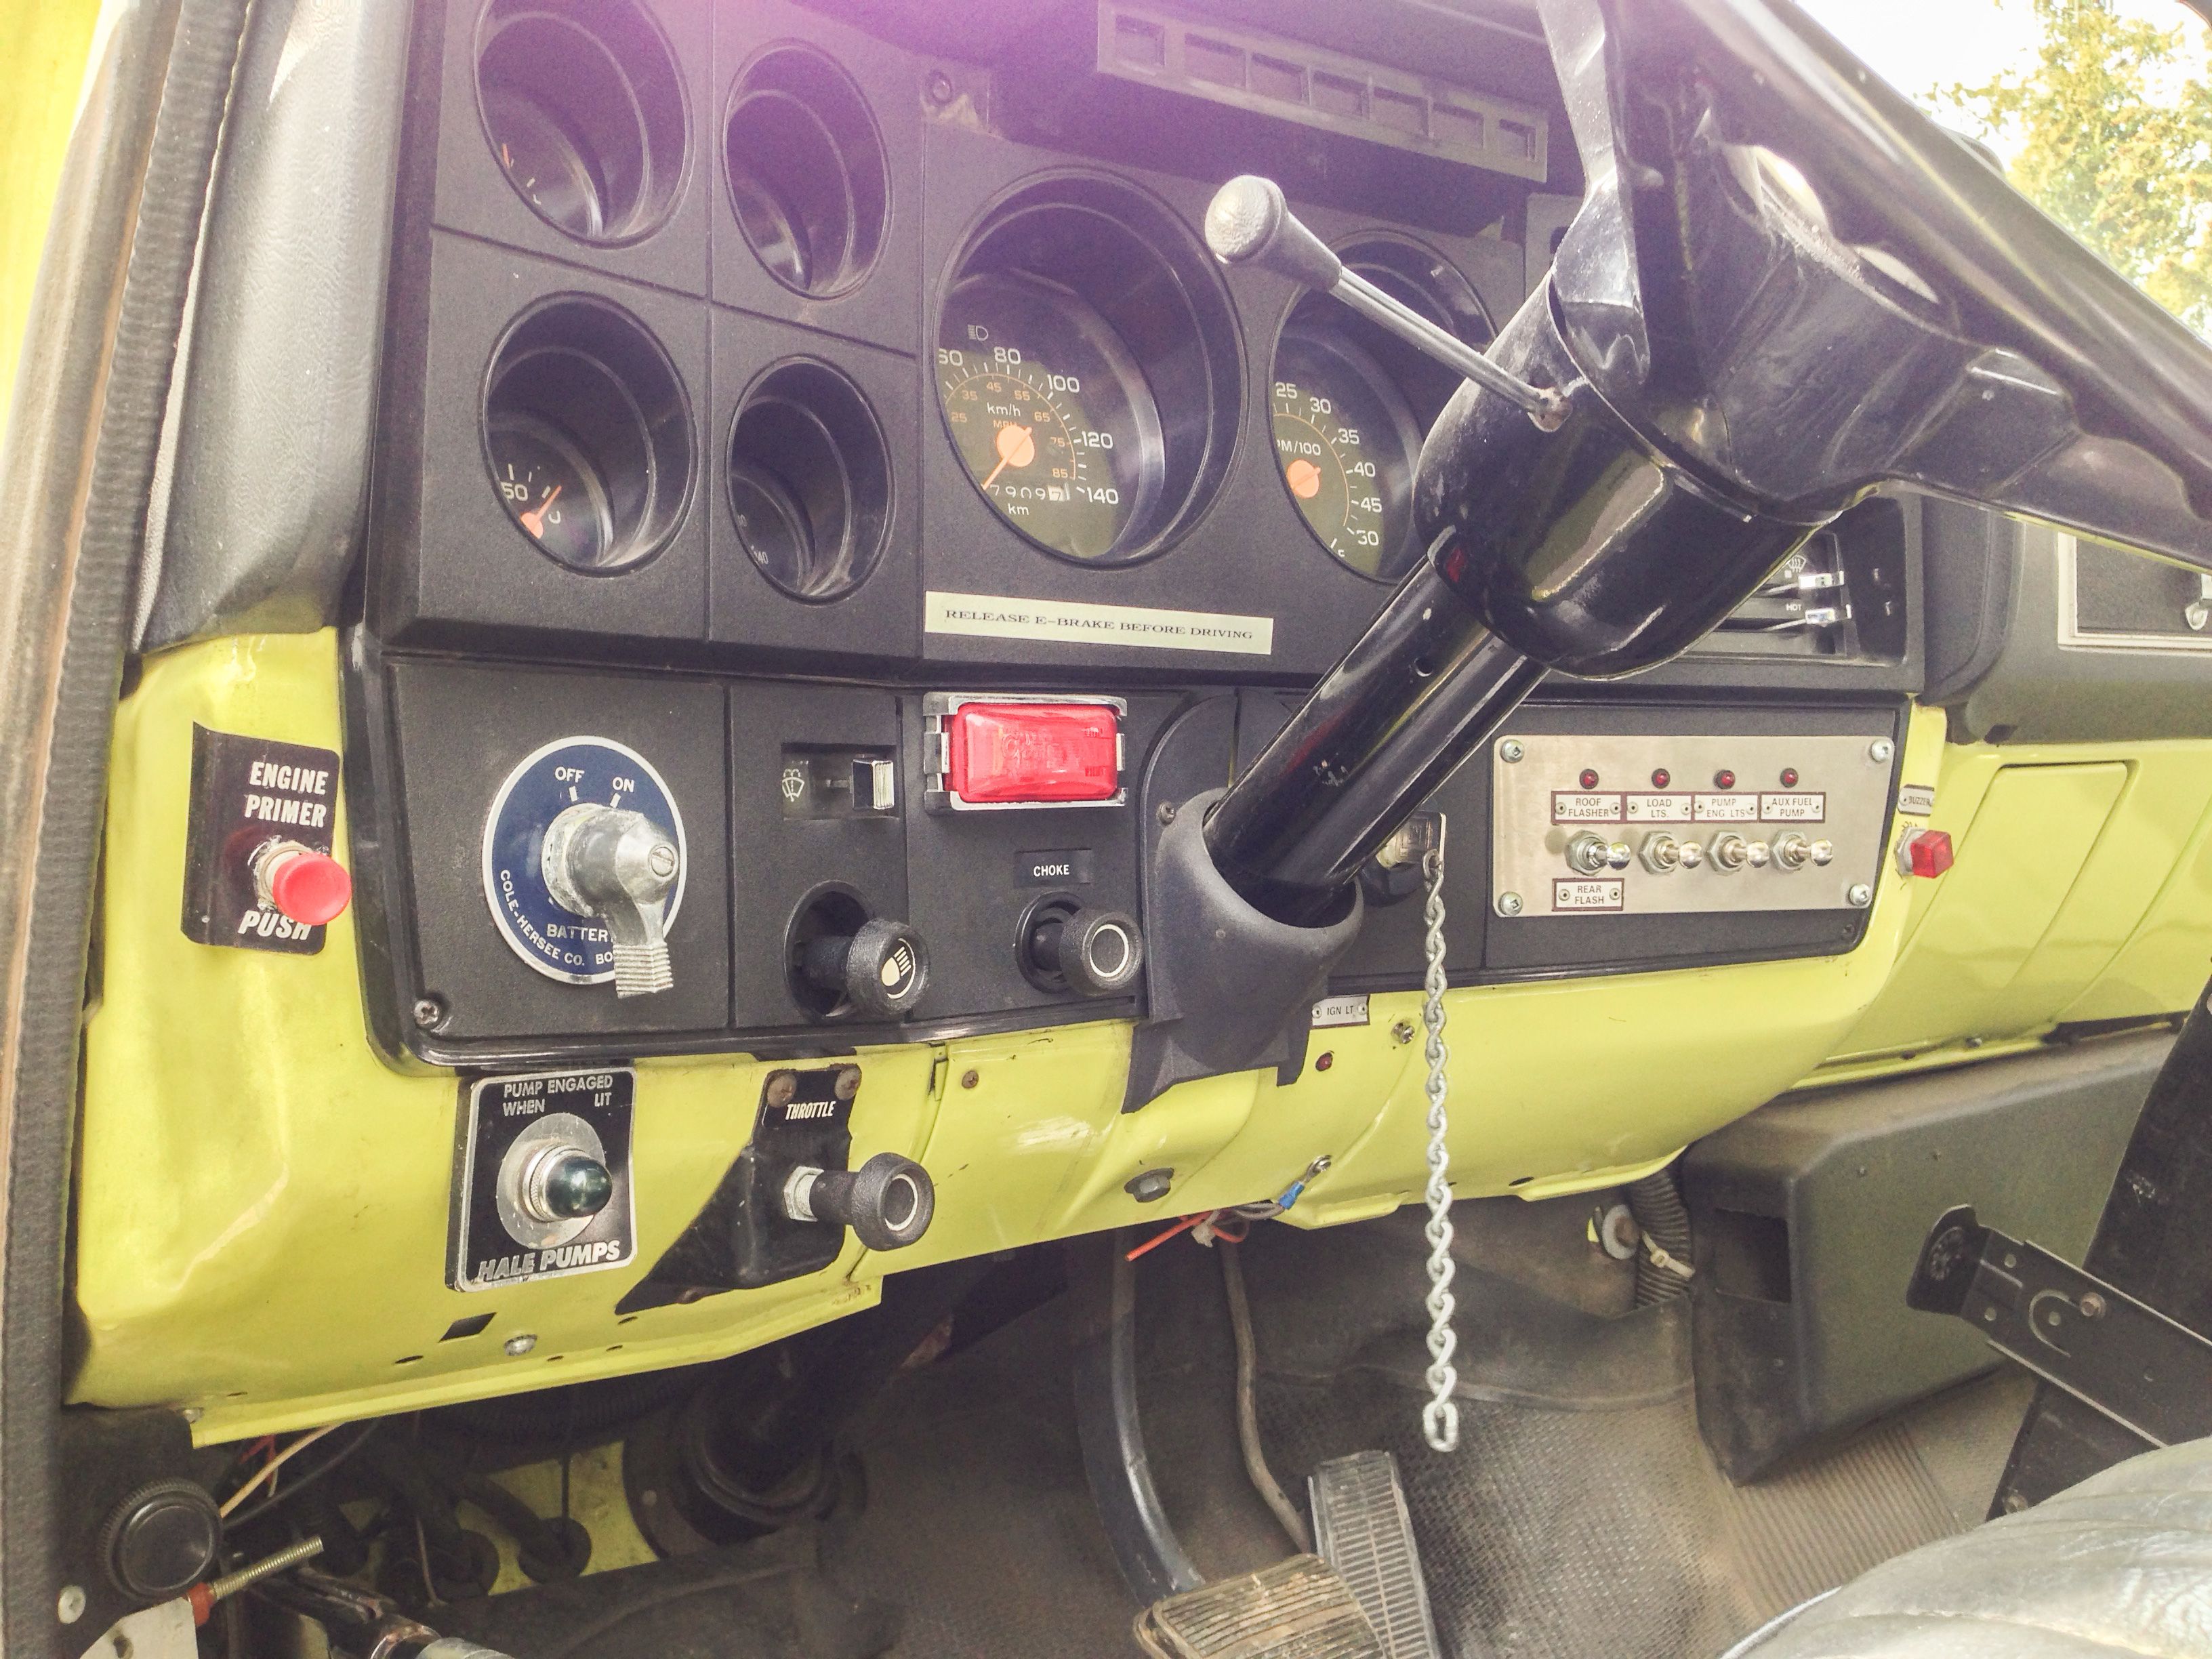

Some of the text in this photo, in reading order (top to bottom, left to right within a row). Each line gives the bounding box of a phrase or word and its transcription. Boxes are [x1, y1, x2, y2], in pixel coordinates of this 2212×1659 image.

[994, 346, 1021, 365] 80
[986, 382, 1002, 392] 45
[1047, 374, 1080, 393] 100
[1275, 382, 1297, 399] 25
[962, 390, 978, 401] 35
[1014, 390, 1030, 401] 55
[987, 402, 1021, 417] km/h
[1309, 396, 1332, 415] 30
[1034, 411, 1050, 423] 65
[1050, 436, 1065, 448] 75
[1081, 431, 1113, 449] 120
[1338, 428, 1359, 445] 35
[1052, 468, 1068, 478] 85
[1354, 462, 1376, 478] 40
[1086, 486, 1119, 504] 140
[1008, 503, 1029, 515] km
[1360, 497, 1382, 513] 45
[1786, 603, 1802, 611] HOT
[945, 609, 1254, 640] RELEASE E-BRAKE BEFORE DRIVING
[249, 760, 329, 796] ENGINE
[554, 766, 585, 785] OFF
[612, 777, 634, 793] ON
[1575, 798, 1601, 807] ROOF
[1647, 798, 1672, 807] LOAD
[1711, 798, 1736, 806] PUMP
[1771, 797, 1813, 806] AUX FUEL
[244, 794, 327, 828] PRIMER
[1568, 808, 1610, 817] FLASHER
[1651, 808, 1669, 818] LTS.
[1706, 808, 1746, 817] ENG LTS
[1780, 808, 1805, 817] PUMP
[1033, 864, 1069, 877] CHOKE
[1577, 884, 1601, 894] REAR
[1574, 895, 1605, 905] FLASH
[237, 909, 312, 941] PUSH
[547, 923, 613, 943] BATTER
[564, 953, 585, 966] CO.
[1327, 1005, 1354, 1015] IGN LT
[504, 1075, 613, 1098] PUMP ENGAGED
[503, 1092, 612, 1116] WHEN LIT
[785, 1101, 836, 1120] THROTTLE
[477, 1240, 620, 1282] HALE PUMPS
